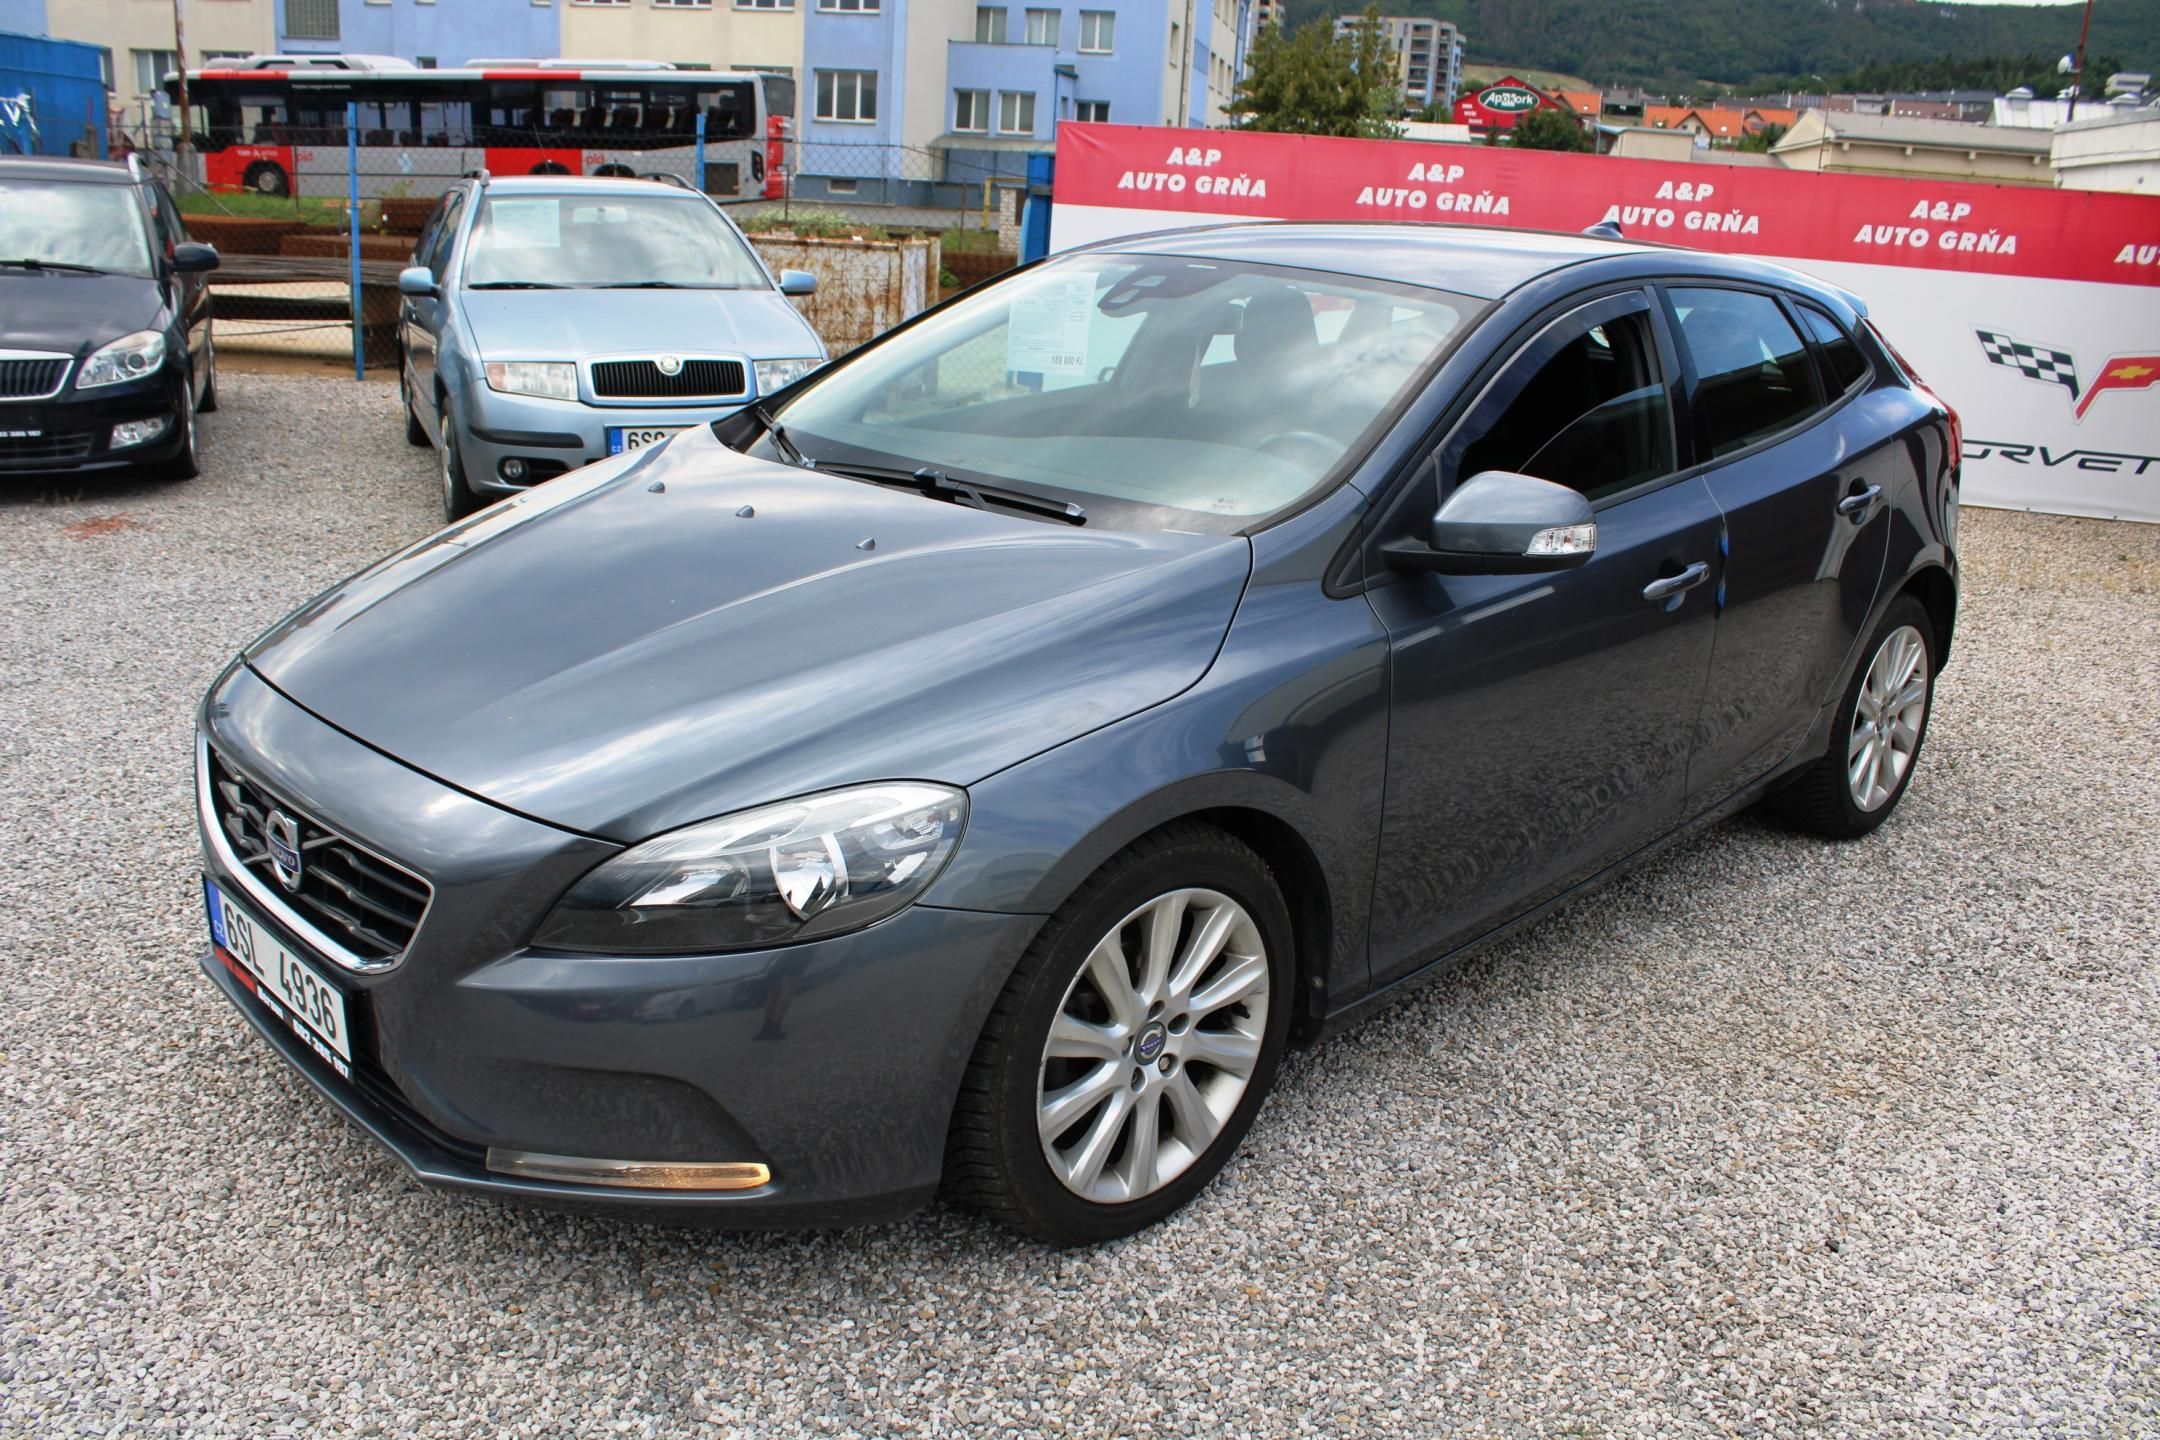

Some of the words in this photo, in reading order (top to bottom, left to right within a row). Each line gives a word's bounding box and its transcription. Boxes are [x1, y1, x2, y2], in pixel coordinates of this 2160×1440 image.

[1166, 147, 1222, 167] A&P
[1117, 171, 1186, 192] AUTO
[1195, 173, 1266, 198] GRŇA
[1407, 163, 1464, 183] A&P
[1356, 187, 1427, 209] AUTO
[1436, 190, 1510, 215] GRŇA
[1655, 181, 1714, 202] A&P
[1602, 205, 1675, 228] AUTO
[1684, 209, 1759, 234] GRŇA
[1909, 200, 1971, 221] A&P
[1853, 224, 1929, 248] AUTO
[1939, 229, 2016, 255] GRŇA
[214, 920, 225, 937] CZ
[224, 902, 264, 977] 6SL
[280, 951, 337, 1040] 4936
